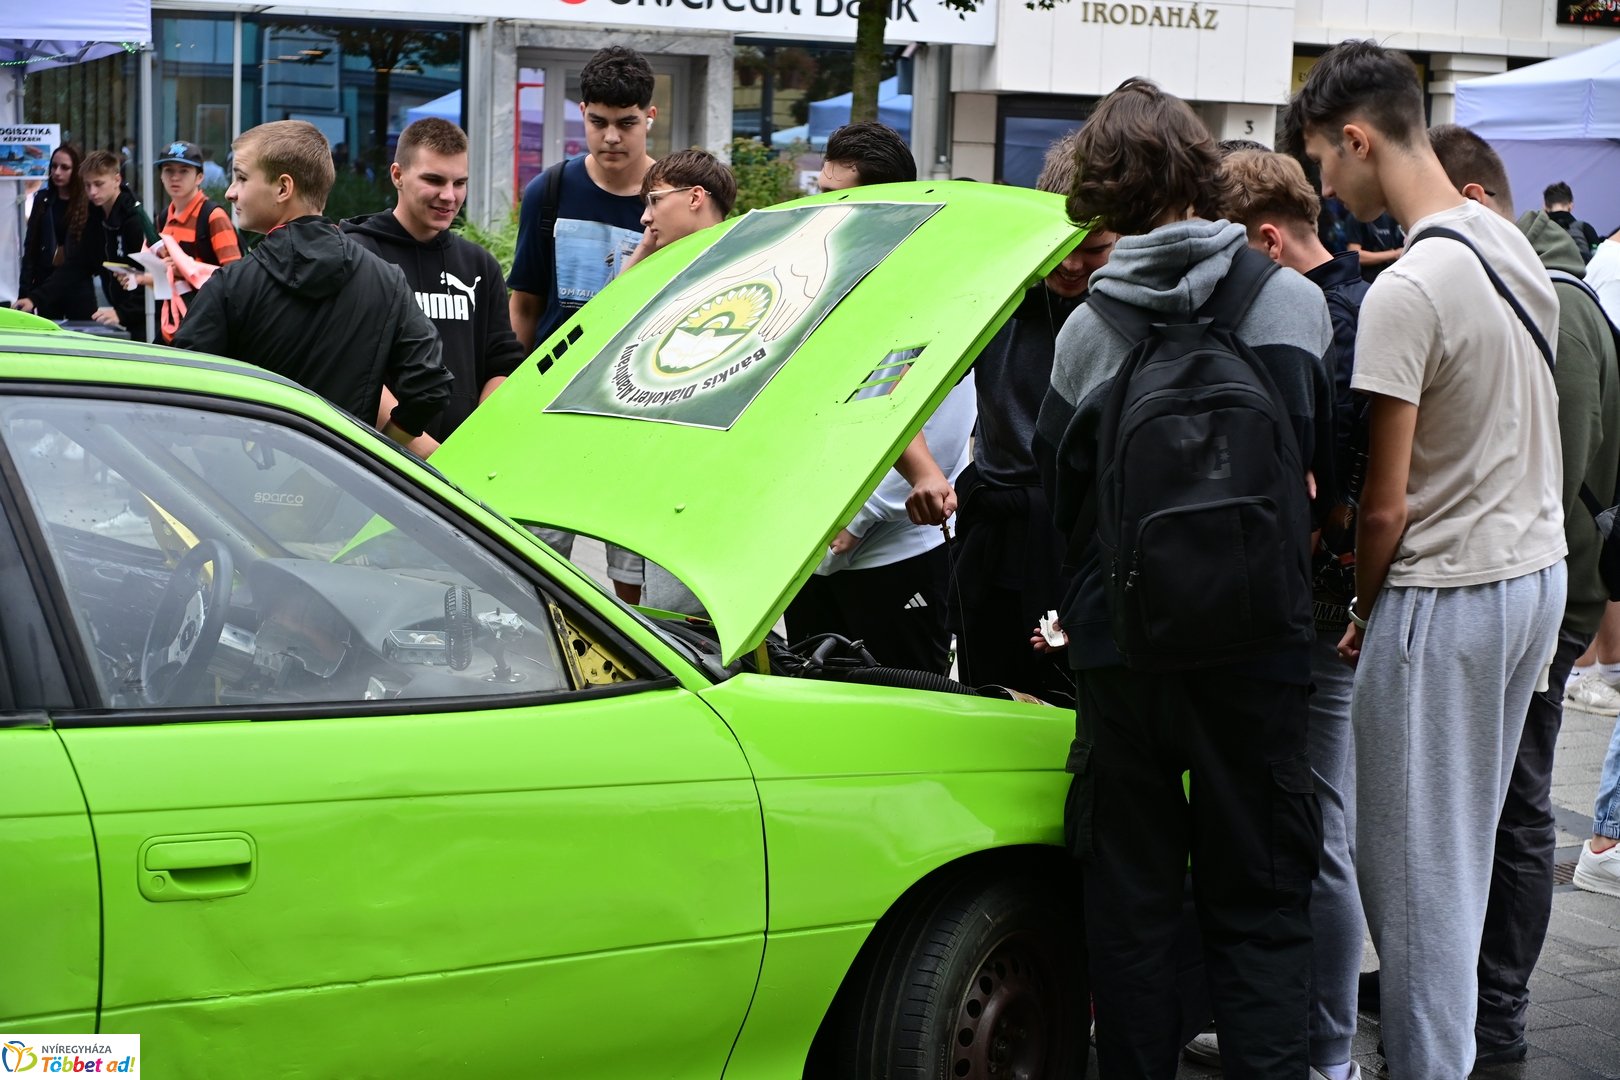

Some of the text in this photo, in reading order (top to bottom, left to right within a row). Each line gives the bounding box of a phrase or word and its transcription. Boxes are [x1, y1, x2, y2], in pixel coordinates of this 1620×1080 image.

[1081, 1, 1219, 30] IRODAHÁZ
[0, 127, 51, 136] OGISZTIKA
[1244, 119, 1254, 135] 3
[414, 291, 470, 321] UMA
[701, 347, 767, 389] Bánkis
[626, 383, 698, 407] Diákokért
[254, 491, 304, 506] sparco
